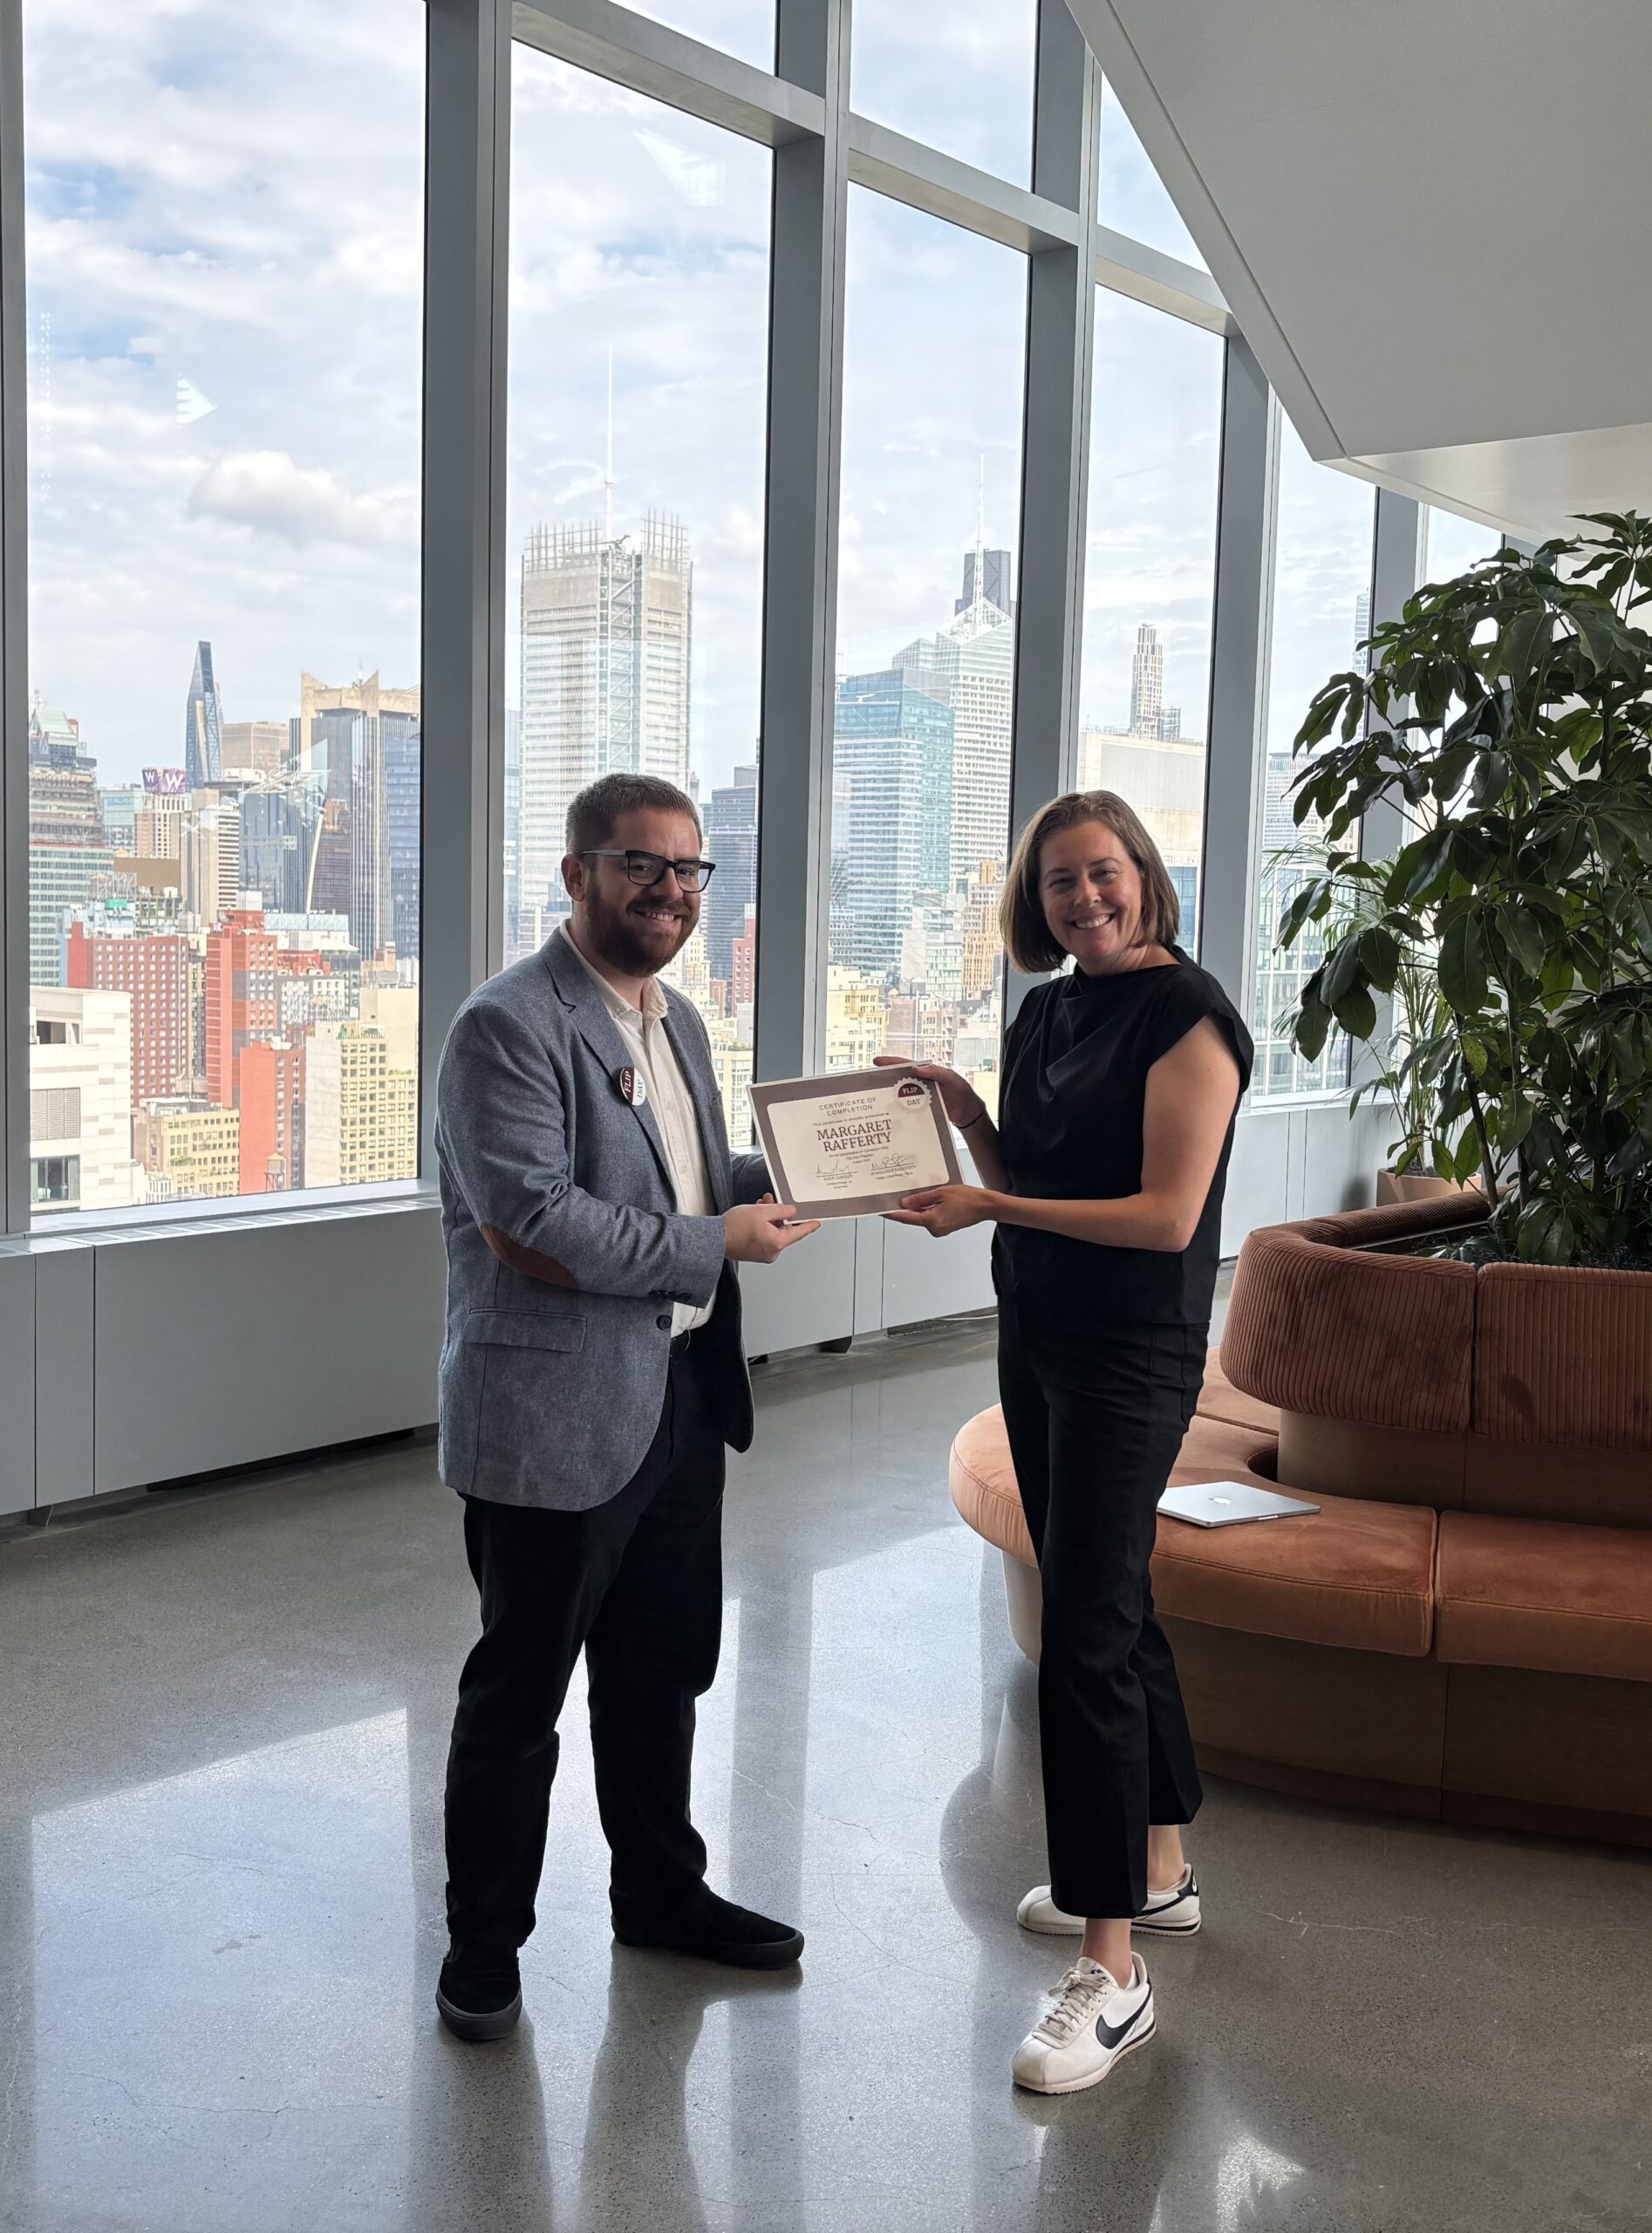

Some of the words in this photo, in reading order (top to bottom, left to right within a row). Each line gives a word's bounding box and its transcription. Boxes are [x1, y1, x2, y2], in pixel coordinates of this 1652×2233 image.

[145, 771, 154, 782] W
[165, 774, 183, 793] W
[819, 1098, 865, 1110] CERTIFICATE
[827, 1104, 872, 1116] COMPLETION
[816, 1119, 892, 1140] MARGARET
[823, 1132, 891, 1151] RAFFERTY
